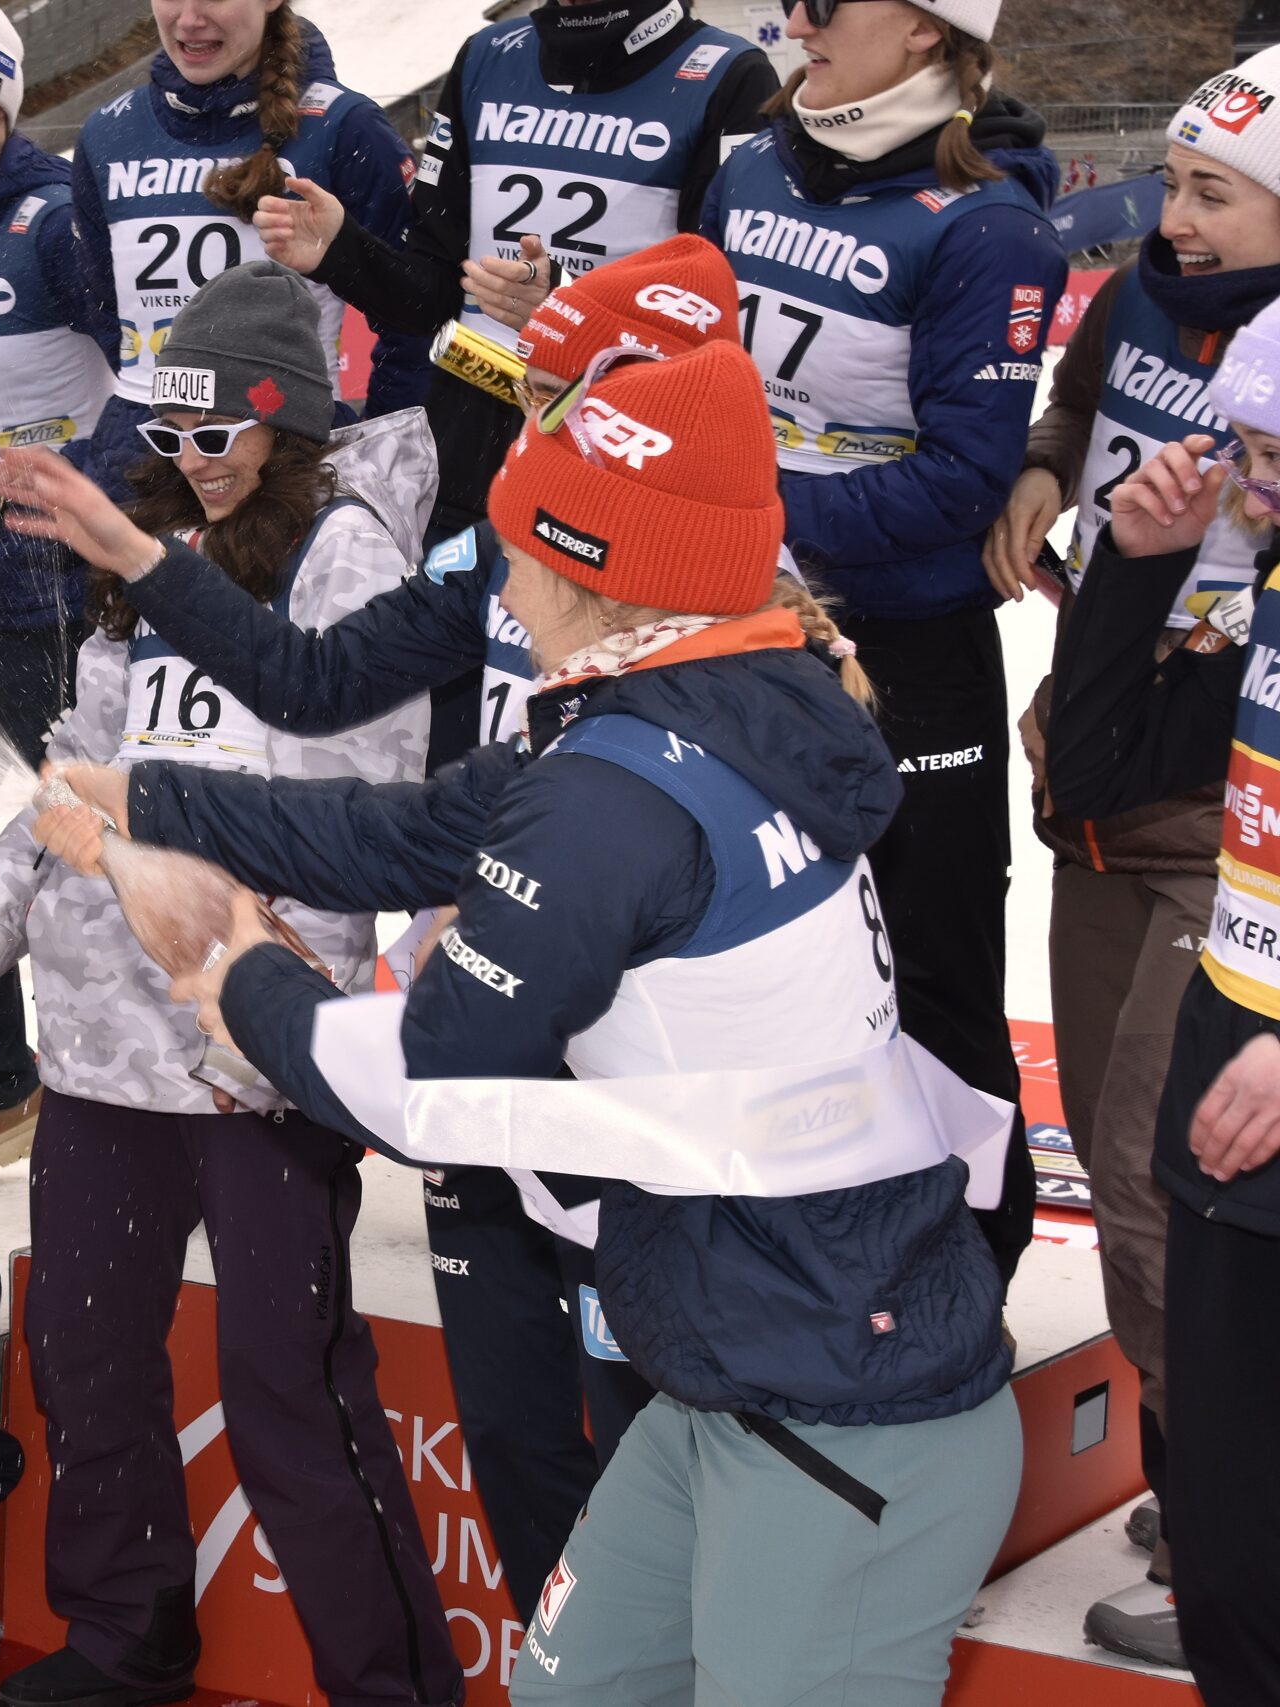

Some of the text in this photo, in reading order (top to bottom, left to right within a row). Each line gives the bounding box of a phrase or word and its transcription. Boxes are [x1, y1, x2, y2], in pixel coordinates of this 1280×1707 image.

[474, 101, 672, 163] Nammo
[492, 173, 608, 257] 22
[135, 222, 242, 291] 20
[724, 208, 889, 295] Nammo
[634, 283, 722, 334] GER
[1014, 287, 1042, 304] NOR
[738, 293, 824, 382] 17
[575, 431, 592, 456] uvex
[578, 397, 673, 471] GER
[550, 526, 604, 563] TERREX
[145, 665, 221, 732] 16
[916, 745, 983, 771] TERREX
[475, 850, 542, 911] ZOLL
[857, 873, 893, 984] 8
